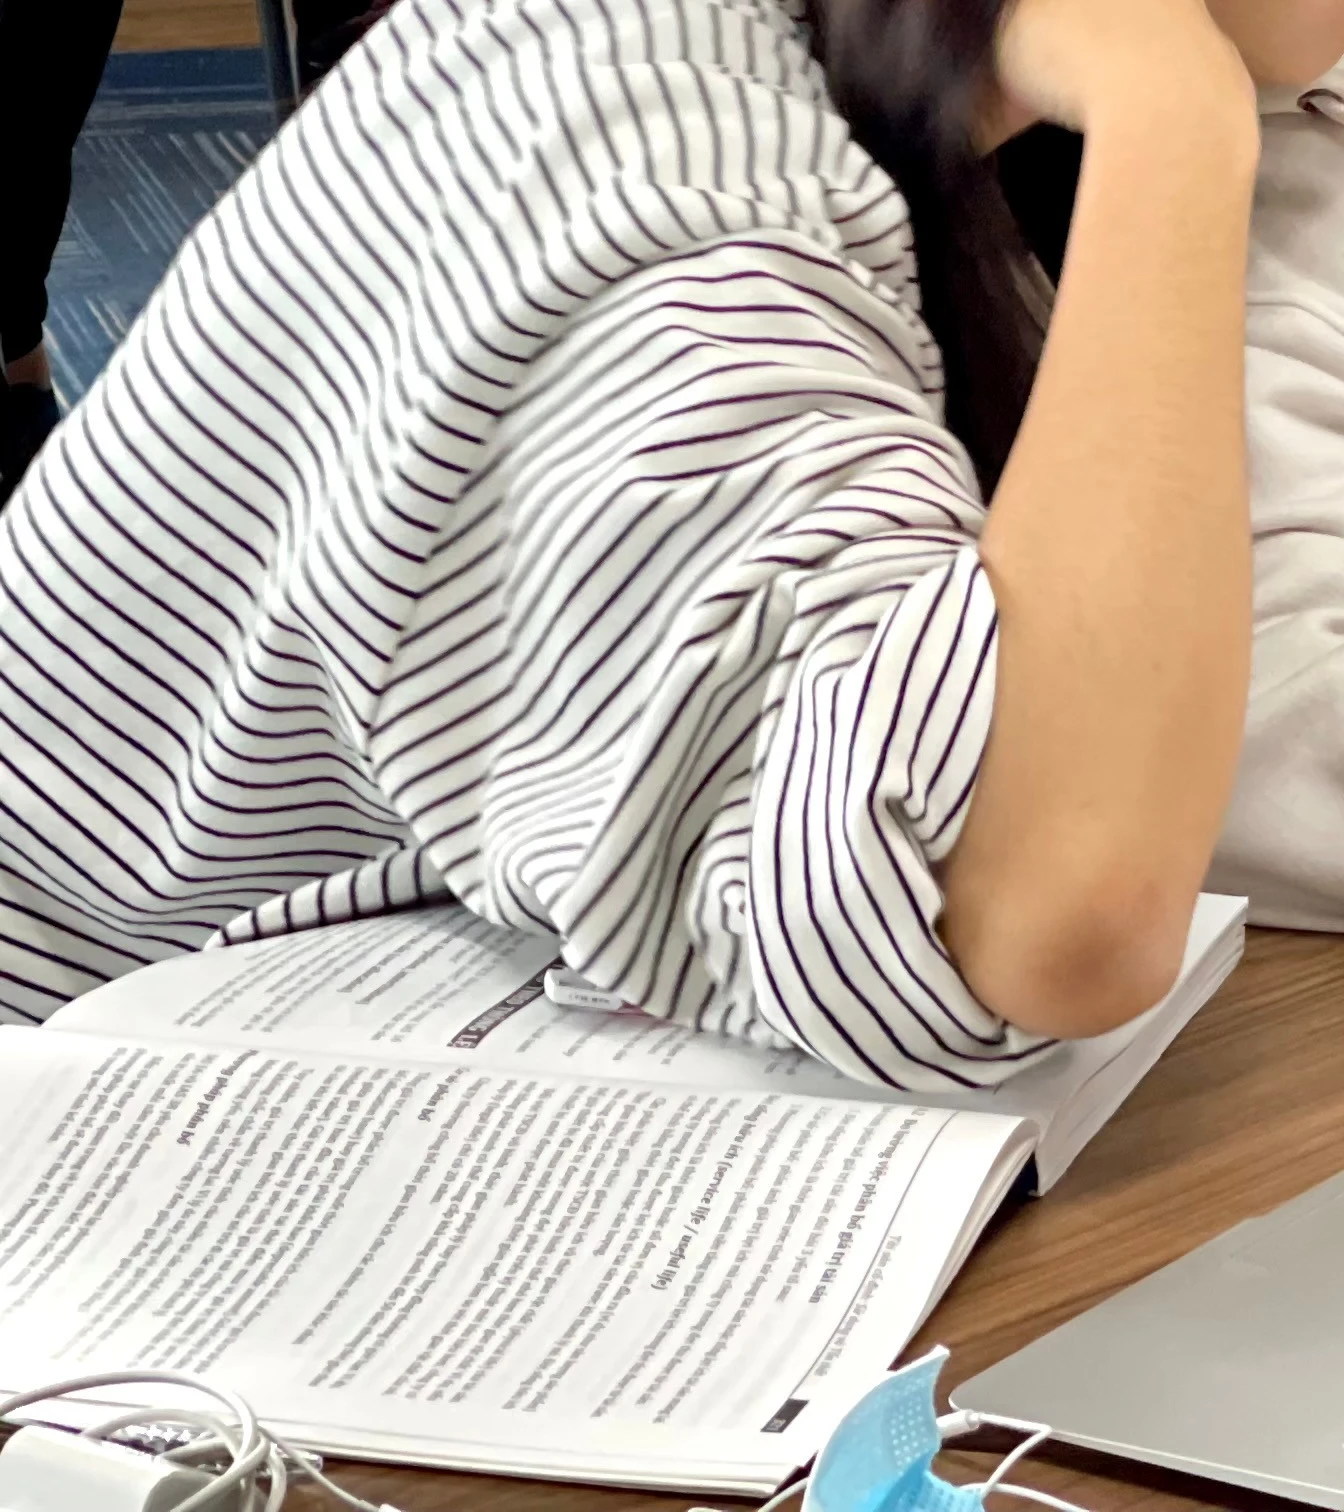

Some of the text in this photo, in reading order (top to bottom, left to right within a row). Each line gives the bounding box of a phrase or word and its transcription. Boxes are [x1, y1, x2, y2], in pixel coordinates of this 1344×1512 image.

[691, 1206, 710, 1224] life
[667, 1235, 692, 1268] useful
[651, 1270, 676, 1290] life)
